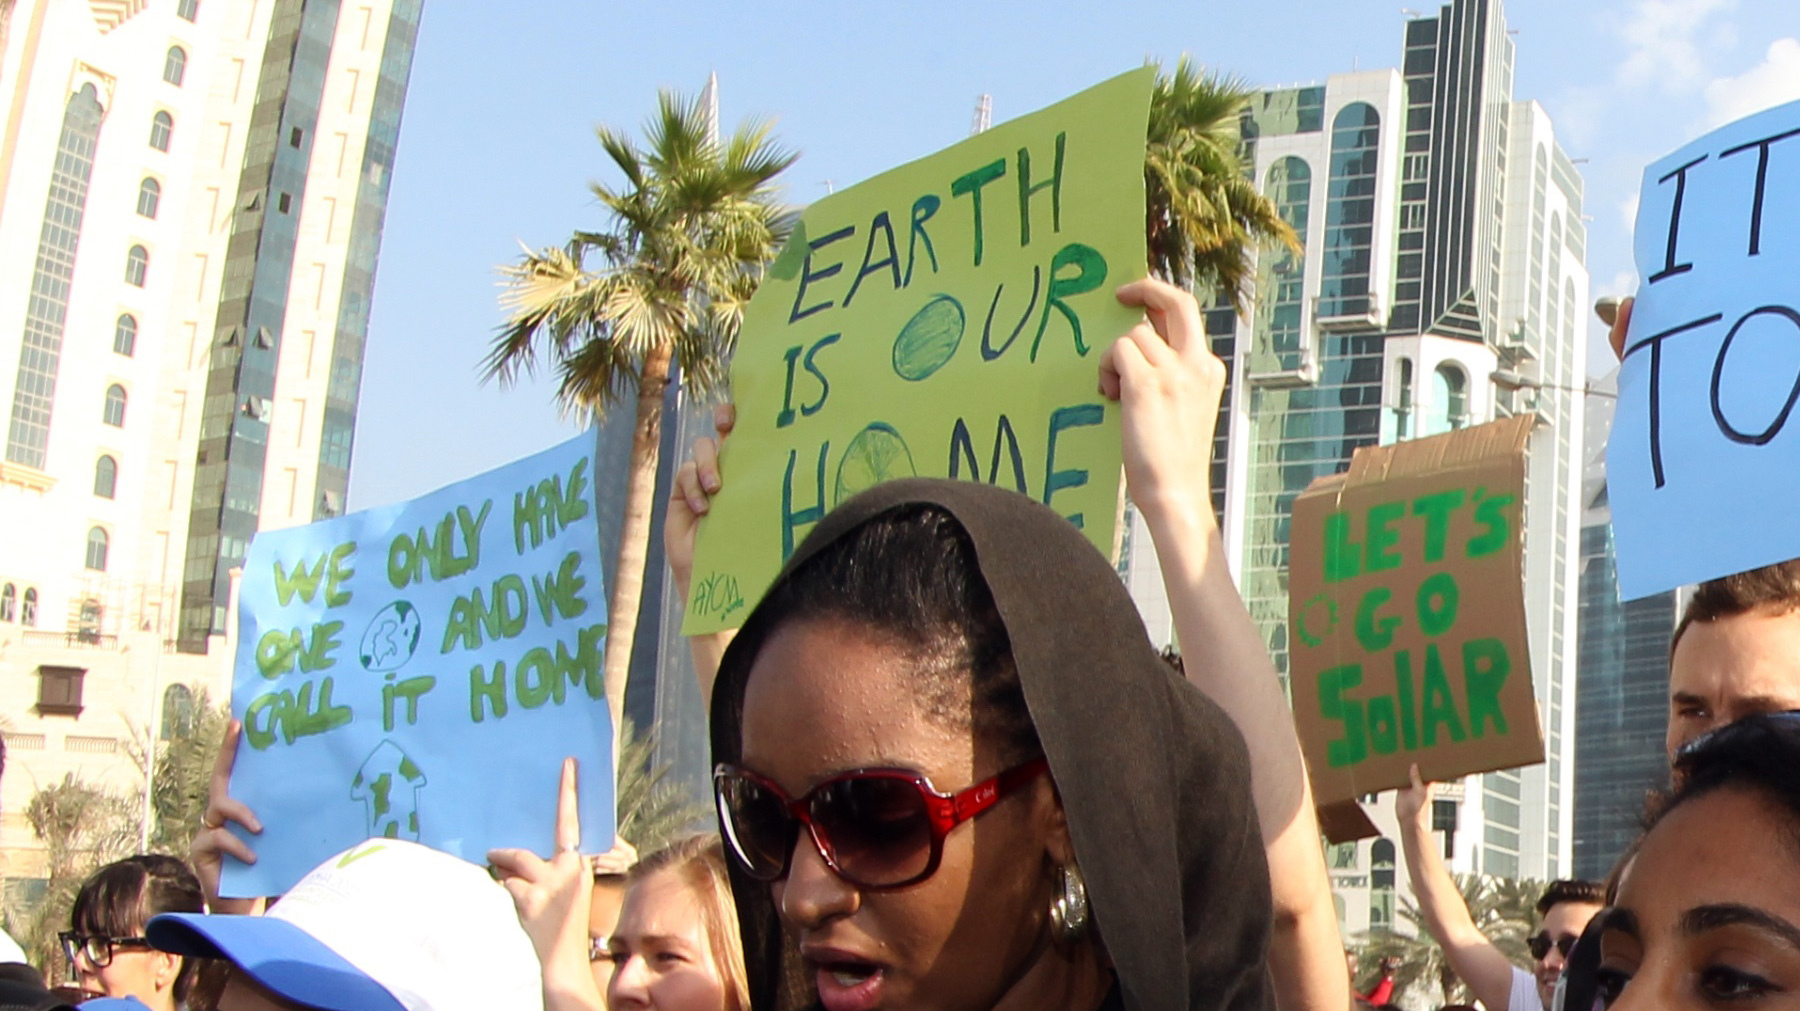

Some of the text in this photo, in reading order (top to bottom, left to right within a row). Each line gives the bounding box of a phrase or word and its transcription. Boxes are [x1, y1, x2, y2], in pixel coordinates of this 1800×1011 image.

[788, 131, 1067, 325] EARTH
[776, 242, 1108, 428] IS OUR
[273, 457, 589, 609] WE ONLY HAVE
[1323, 487, 1515, 584] LET'S
[255, 551, 588, 680] ONE AND WE
[692, 571, 740, 616] AYCM
[1354, 571, 1460, 653] GO
[245, 677, 353, 750] CALL
